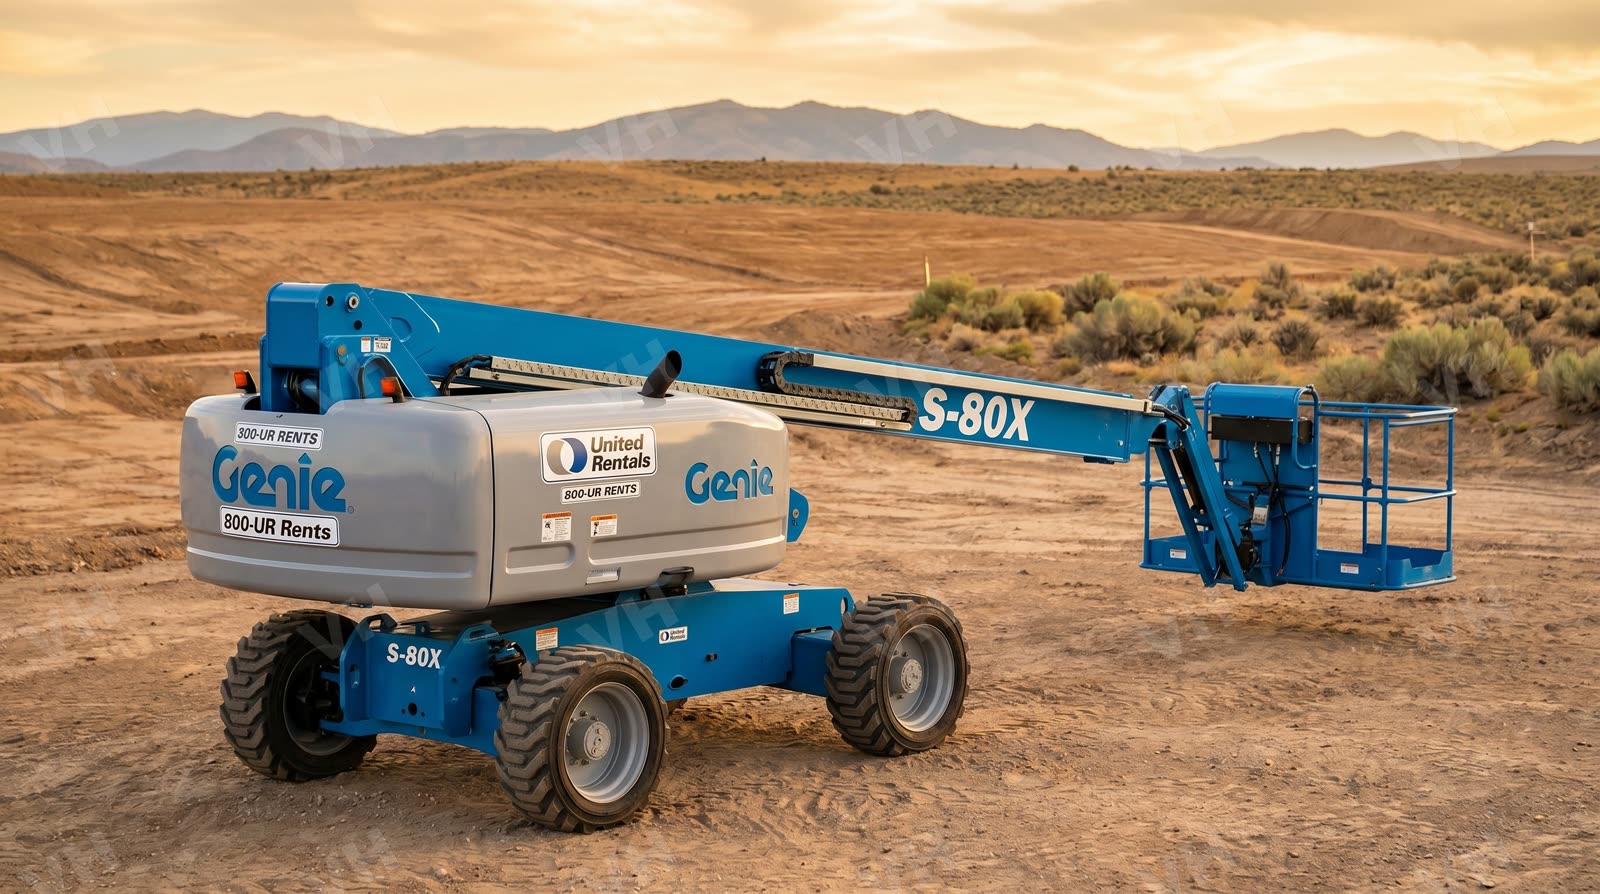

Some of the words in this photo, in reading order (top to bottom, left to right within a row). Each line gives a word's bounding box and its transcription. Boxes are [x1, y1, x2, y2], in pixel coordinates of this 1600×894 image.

[919, 388, 1035, 441] S-80X
[237, 427, 275, 442] 300-UR
[277, 430, 319, 444] RENTS
[590, 434, 644, 453] United
[592, 452, 651, 472] Rentals
[212, 445, 346, 513] Genie
[564, 486, 602, 500] 800-UR
[604, 484, 637, 497] RENTS
[685, 459, 773, 504] Genie
[224, 513, 276, 535] 800-UR
[281, 519, 331, 540] Rents
[386, 643, 442, 669] S-80X
